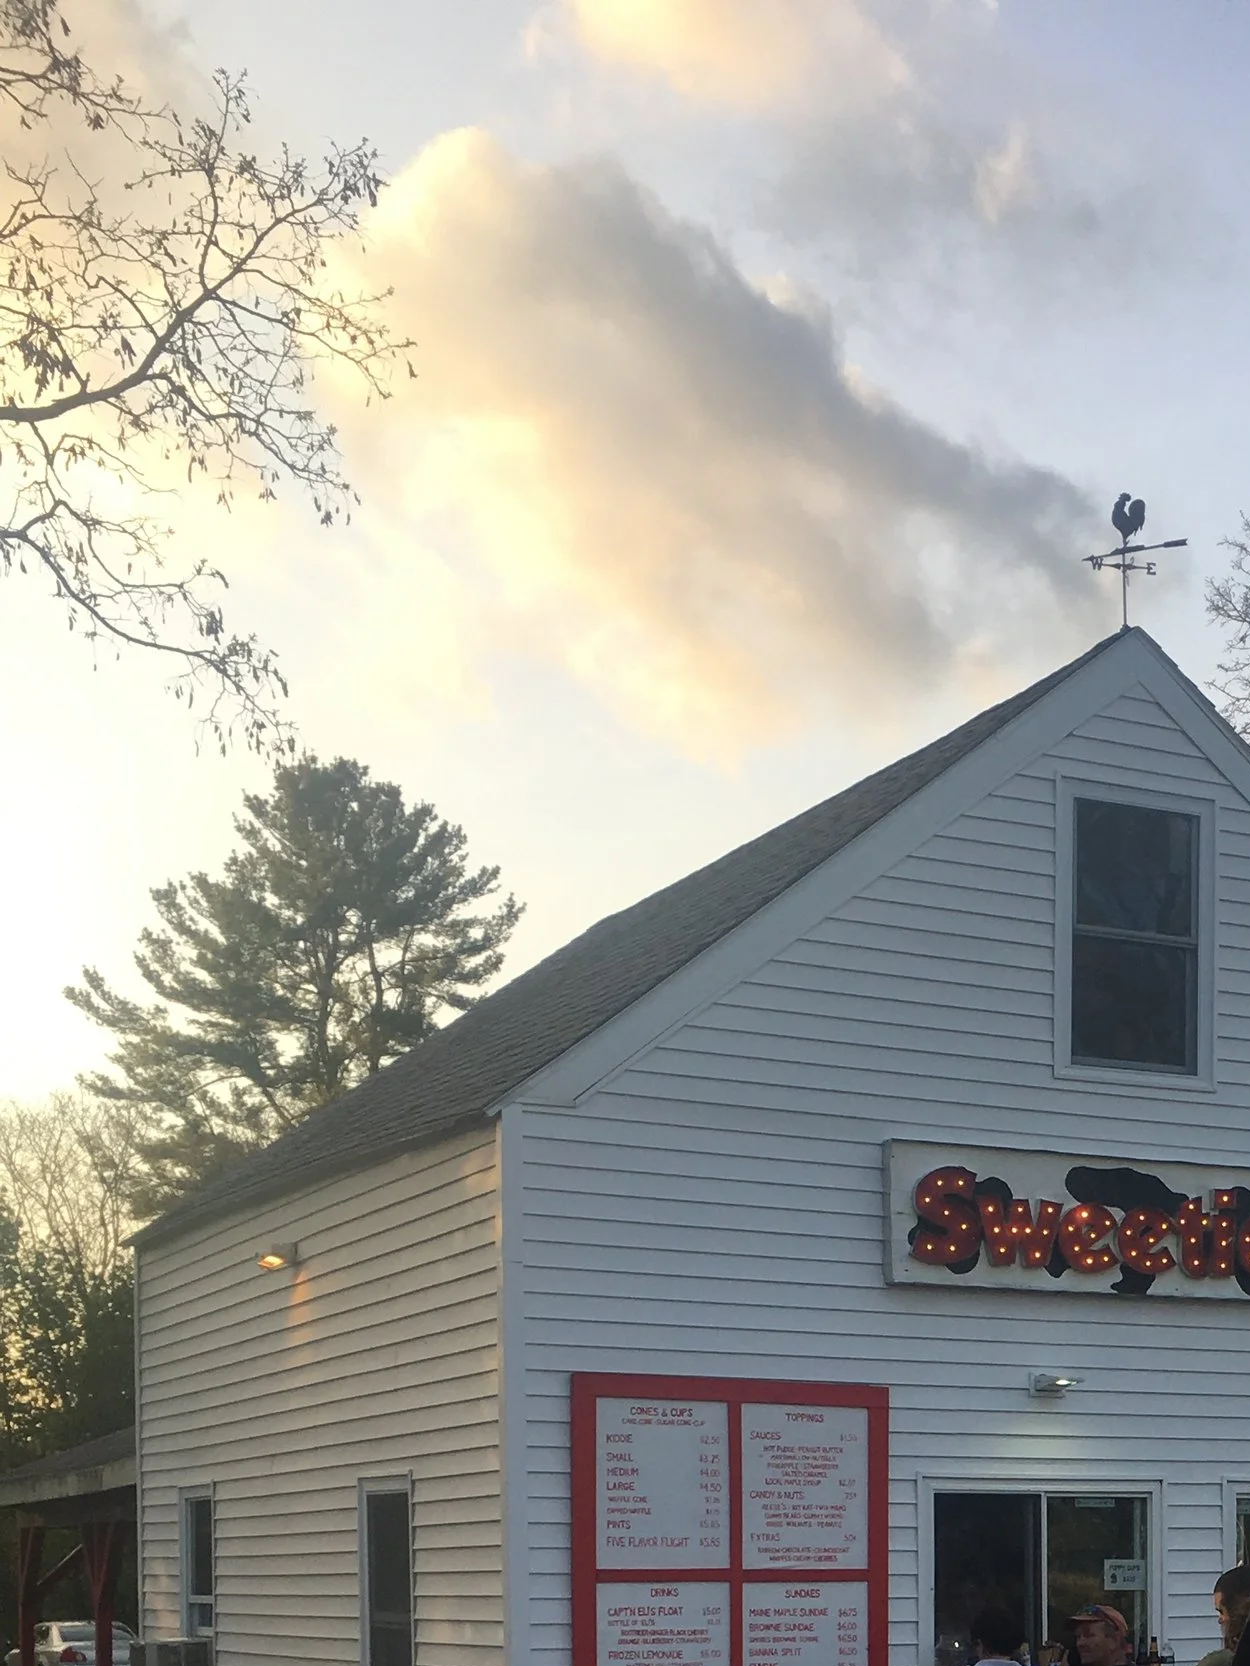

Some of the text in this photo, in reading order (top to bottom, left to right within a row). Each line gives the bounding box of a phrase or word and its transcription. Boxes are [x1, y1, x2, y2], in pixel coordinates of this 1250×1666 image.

[1146, 562, 1157, 576] E
[630, 1406, 693, 1417] CONES & CUPS
[785, 1413, 824, 1423] TOPPINGS
[606, 1434, 633, 1444] KIDDIE
[750, 1431, 782, 1440] SAUCES
[606, 1452, 634, 1462] SMALL
[606, 1467, 639, 1477] MEDIUM
[606, 1481, 722, 1492] LARGE $4.50
[750, 1490, 775, 1500] CANDY
[784, 1491, 804, 1500] NUTS
[606, 1520, 631, 1530] PINTS
[750, 1533, 780, 1541] EXTRAS
[606, 1537, 625, 1547] FIVE
[628, 1537, 658, 1548] FLAVOR
[661, 1537, 690, 1548] FLIGHT
[650, 1588, 679, 1598] DRINKS
[785, 1589, 820, 1598] SUNDAES
[658, 1607, 684, 1616] FLOAT
[702, 1607, 721, 1616] $5.00
[749, 1607, 857, 1617] MAINE MAPLE SUNDAE $6.75
[749, 1623, 782, 1632] BROWNIE
[785, 1623, 814, 1632] SUNDAE
[608, 1651, 640, 1660] FROZEN
[642, 1650, 683, 1660] LEMONADE
[749, 1648, 778, 1657] BANANA
[781, 1648, 801, 1657] SPLIT
